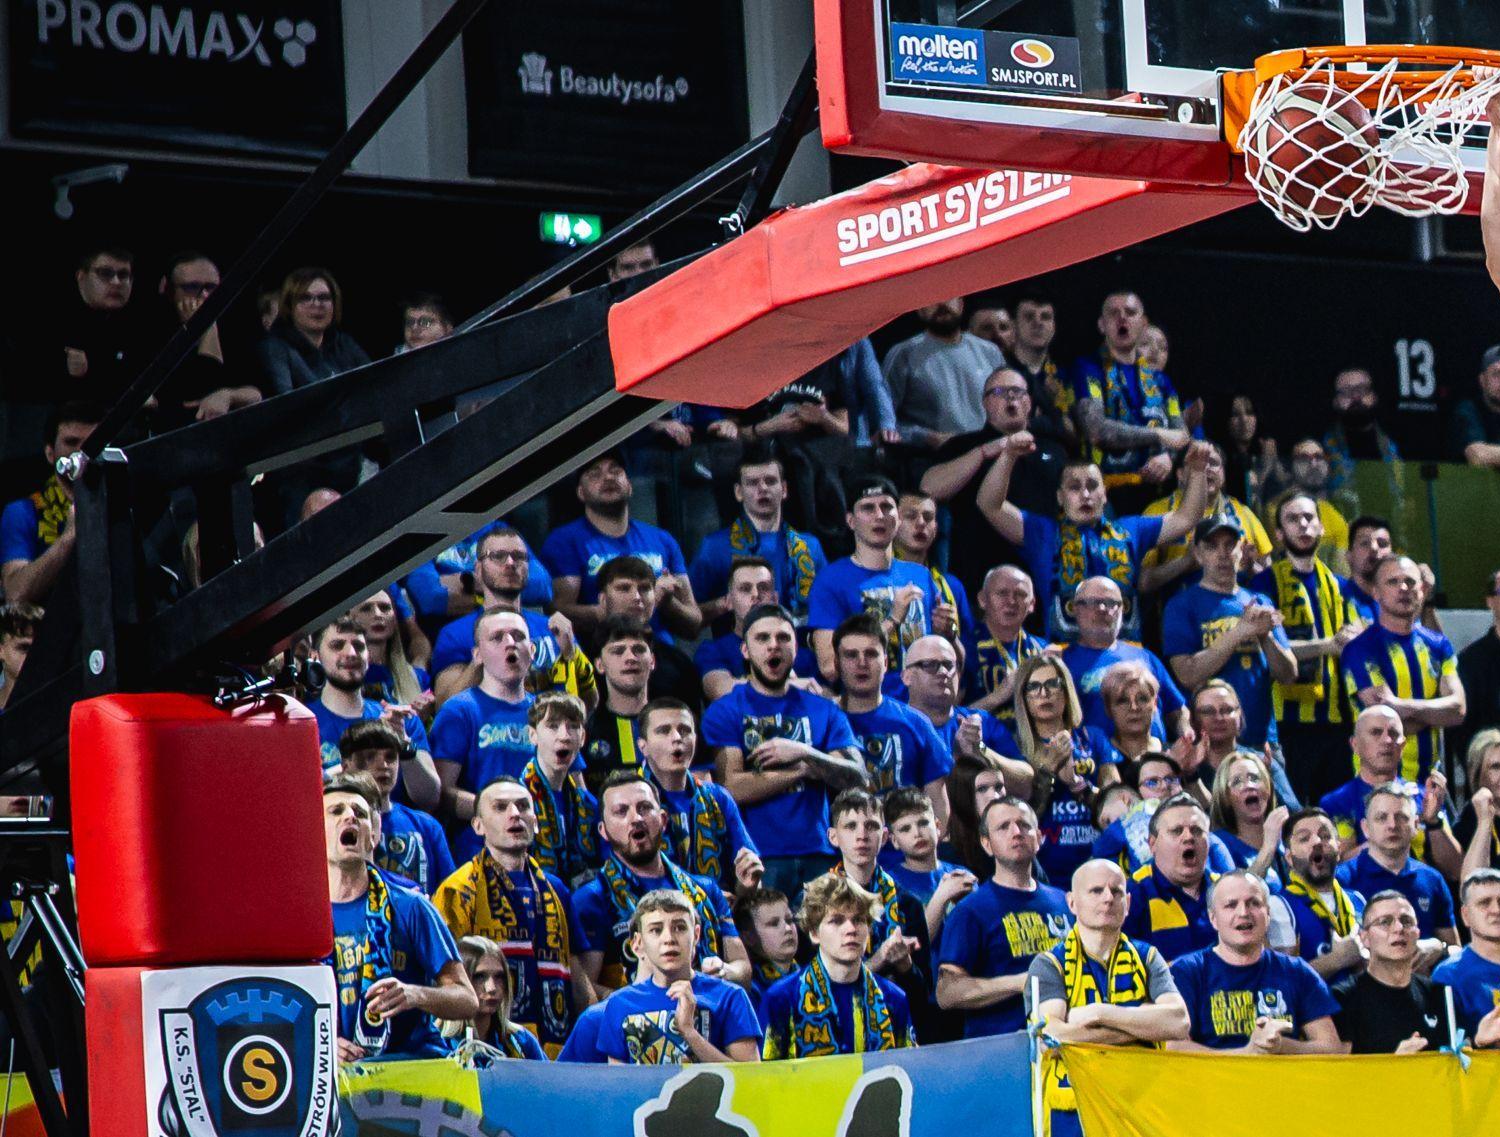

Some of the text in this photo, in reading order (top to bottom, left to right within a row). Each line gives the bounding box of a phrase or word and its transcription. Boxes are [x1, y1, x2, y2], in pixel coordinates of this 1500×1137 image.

[37, 0, 271, 67] PROMAX
[899, 34, 978, 60] molten
[991, 67, 1077, 88] SMJSPORT.PL
[837, 194, 941, 253] SPORT
[1395, 339, 1436, 398] 13
[173, 1027, 191, 1062] K.S.
[242, 1048, 278, 1101] S
